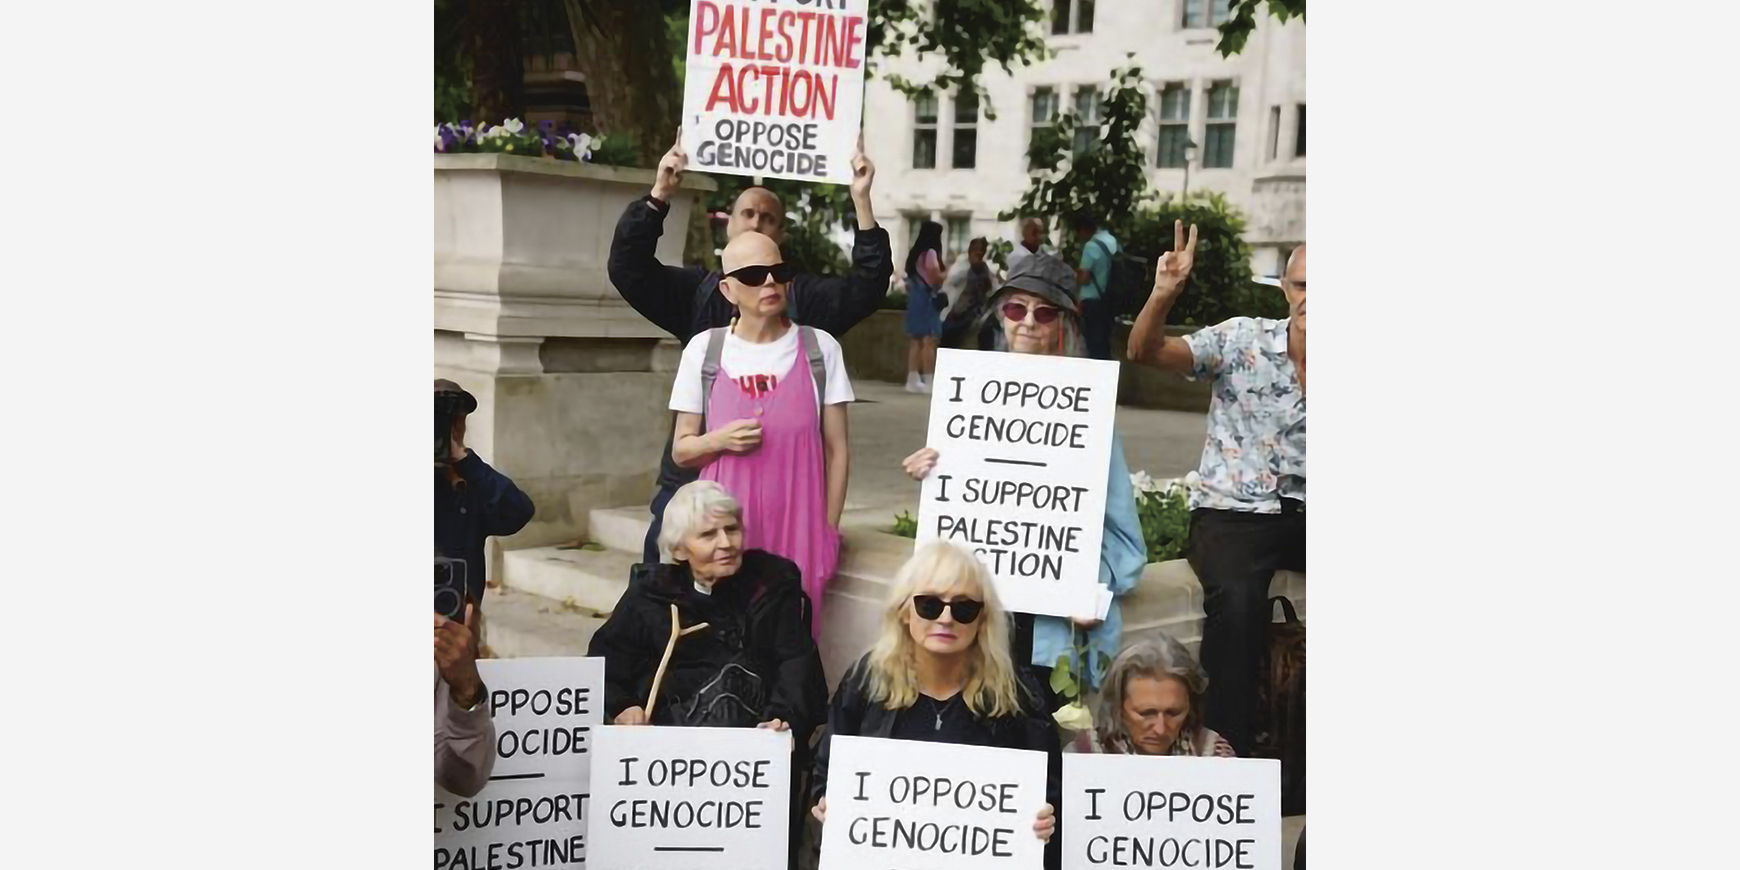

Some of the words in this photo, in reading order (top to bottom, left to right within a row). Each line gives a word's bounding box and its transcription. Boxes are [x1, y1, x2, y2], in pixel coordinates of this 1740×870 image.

[694, 2, 863, 69] PALESTINE
[705, 62, 838, 121] ACTION
[715, 119, 818, 151] OPPOSE
[696, 140, 828, 177] GENOCIDE
[949, 376, 966, 402] I
[981, 380, 1091, 412] OPPOSE
[946, 414, 1089, 449] GENOCIDE
[935, 474, 952, 502] I
[962, 478, 1089, 512] SUPPORT
[937, 515, 1083, 553] PALESTINE
[973, 548, 1063, 580] TION
[490, 687, 590, 718] PPOSE
[496, 726, 590, 759] OCIDE
[618, 757, 639, 786] I
[647, 758, 771, 789] OPPOSE
[853, 771, 872, 801] I
[889, 775, 1019, 813] OPPOSE
[1084, 788, 1106, 820] I
[1123, 790, 1256, 825] OPPOSE
[453, 793, 591, 831] SUPPORT
[610, 799, 764, 829] GENOCIDE
[434, 835, 586, 870] PALESTINE
[848, 816, 1015, 857] GENOCIDE
[1086, 835, 1256, 869] GENOCIDE
